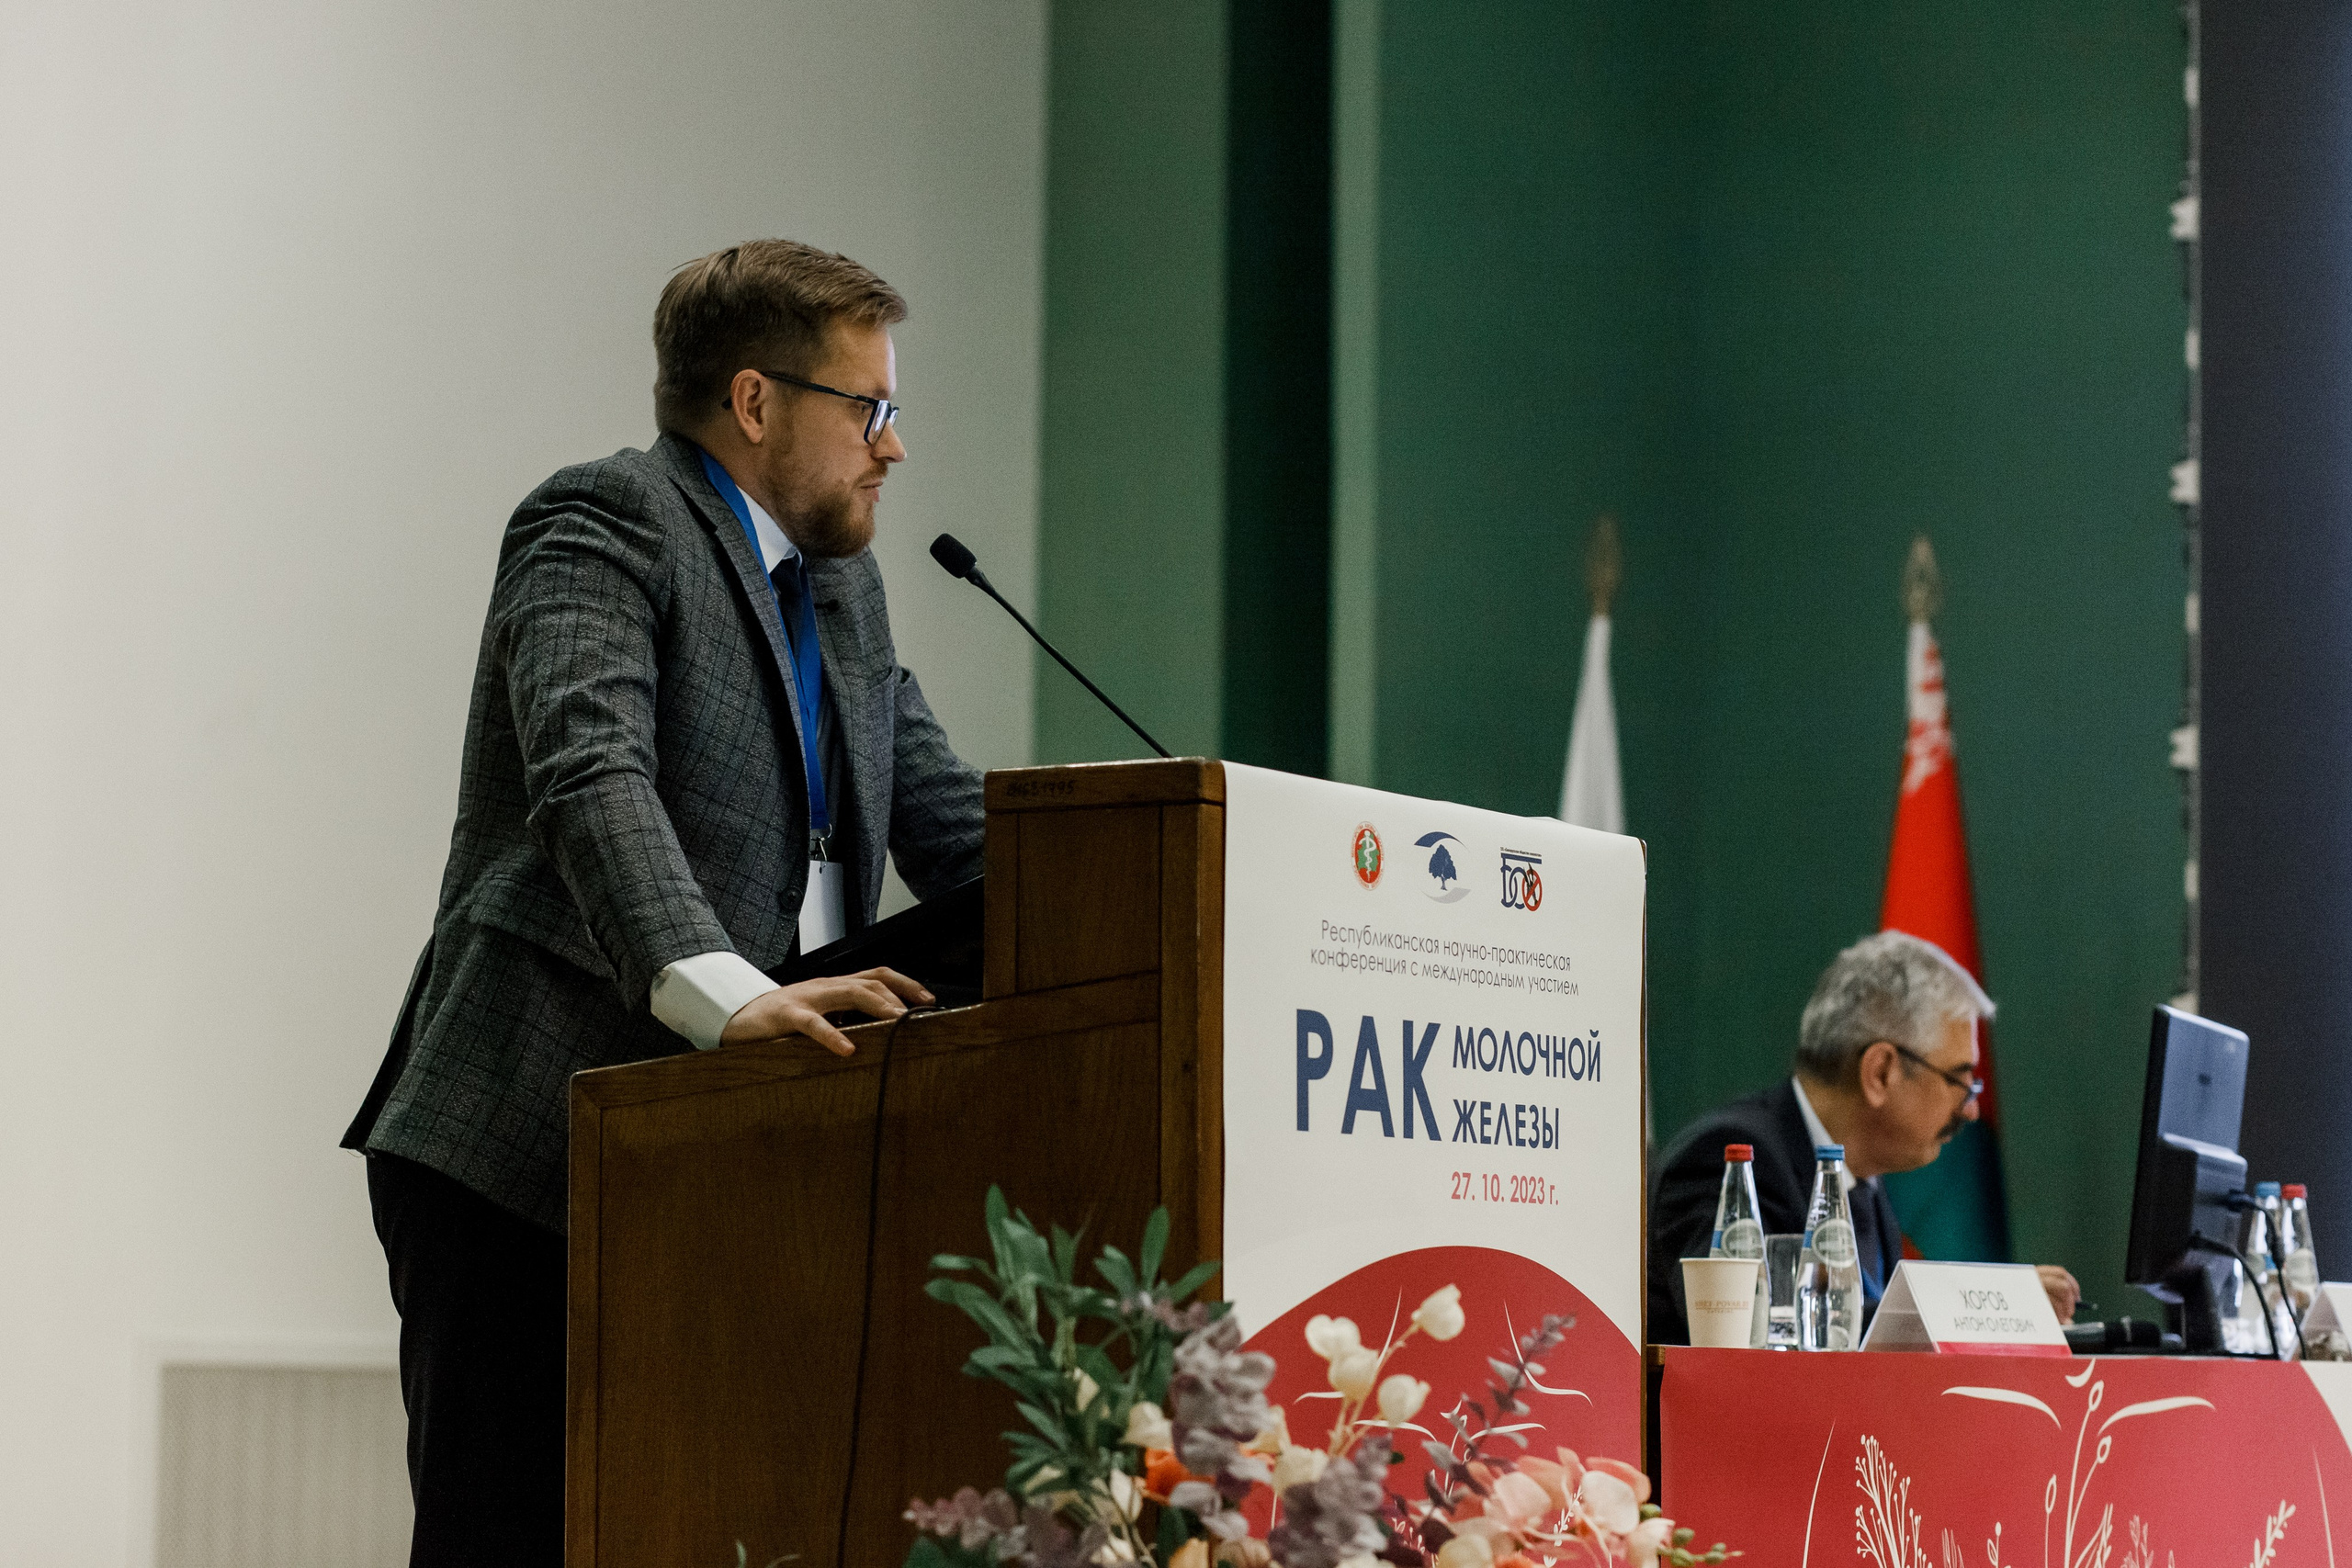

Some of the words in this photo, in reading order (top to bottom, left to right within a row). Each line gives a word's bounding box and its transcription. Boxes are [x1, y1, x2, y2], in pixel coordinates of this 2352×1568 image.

[1321, 919, 1440, 954] Республиканская
[1442, 940, 1571, 972] научно-практическая
[1310, 947, 1407, 975] конференция
[1410, 961, 1419, 976] с
[1421, 963, 1525, 989] международным
[1527, 975, 1579, 997] участием
[1296, 1009, 1442, 1142] РАК
[1453, 1025, 1601, 1083] МОЛОЧНОЙ
[1452, 1099, 1560, 1150] ЖЕЛЕЗЫ
[1451, 1171, 1476, 1201] 27.
[1481, 1173, 1505, 1202] 10.
[1510, 1175, 1545, 1205] 2023
[1549, 1184, 1559, 1206] г.
[1958, 1289, 2009, 1311] ХОРОВ
